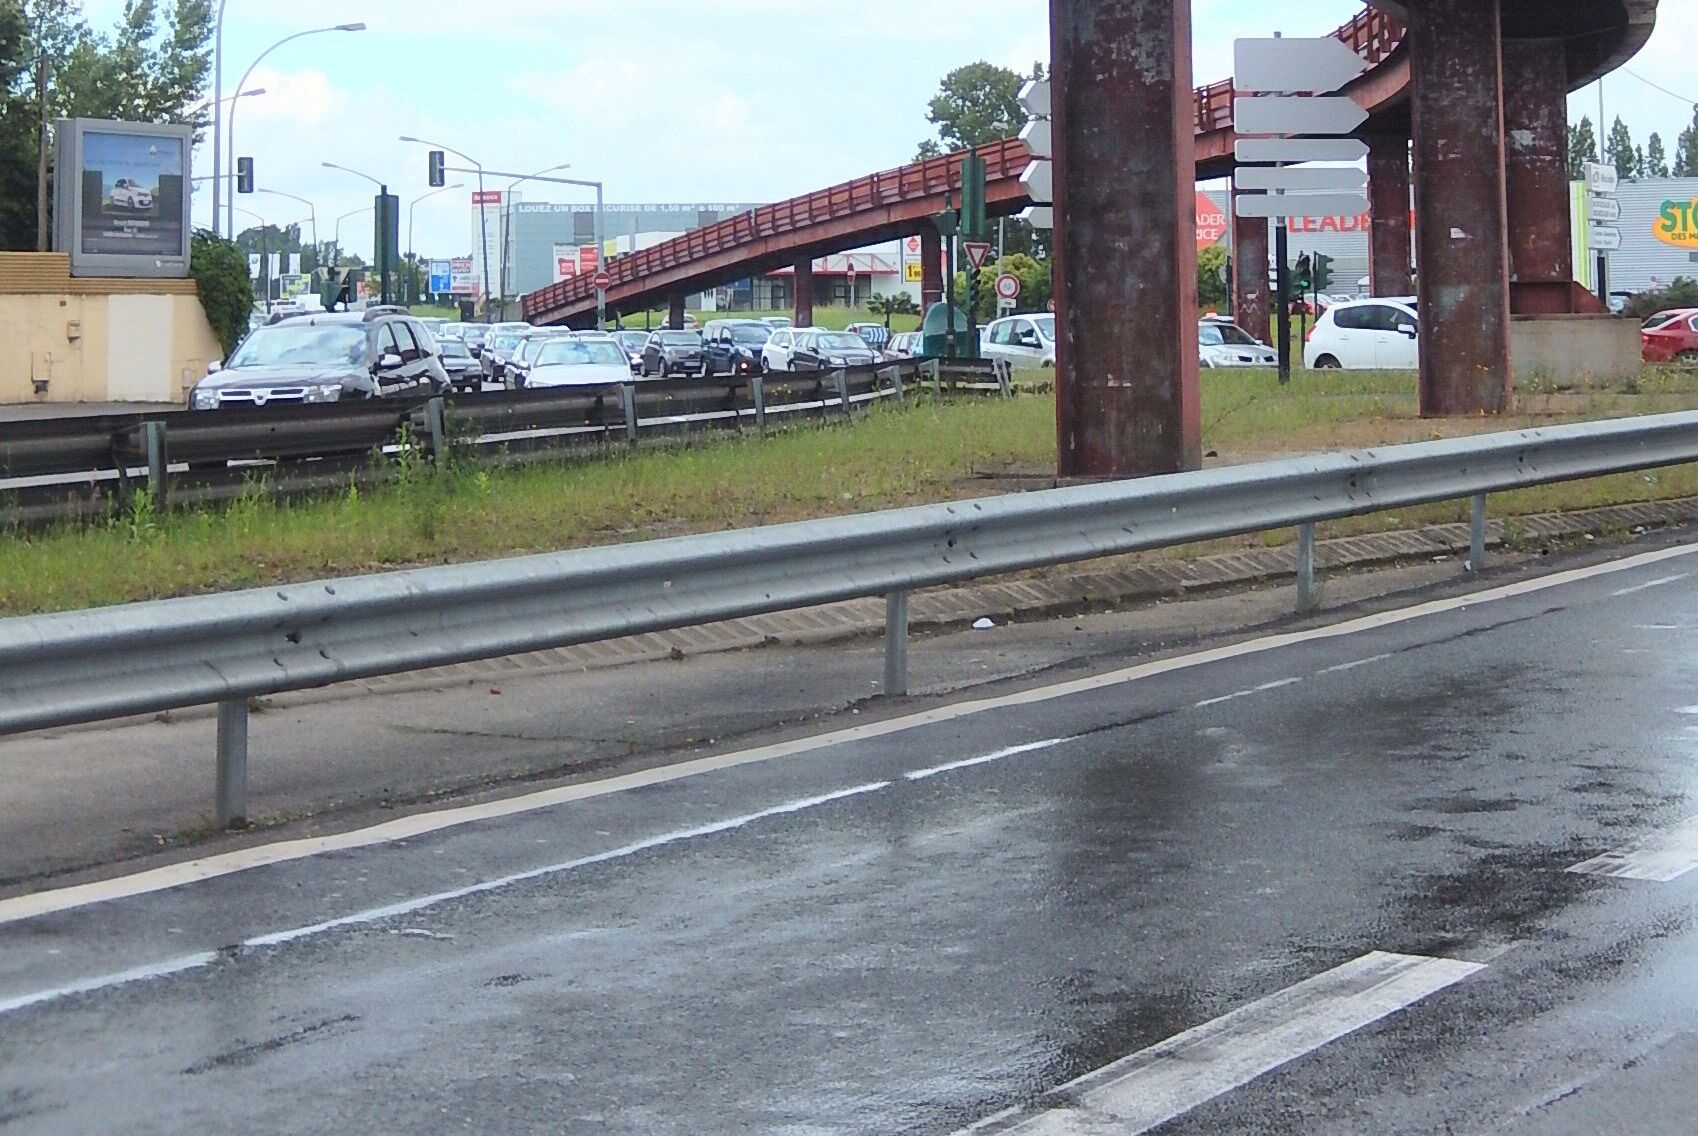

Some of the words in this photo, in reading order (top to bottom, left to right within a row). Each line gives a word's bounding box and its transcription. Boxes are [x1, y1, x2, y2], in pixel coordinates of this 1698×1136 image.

[518, 204, 552, 213] LOUEZ
[554, 204, 569, 213] UN
[570, 204, 592, 213] BOX
[1671, 232, 1687, 240] DES
